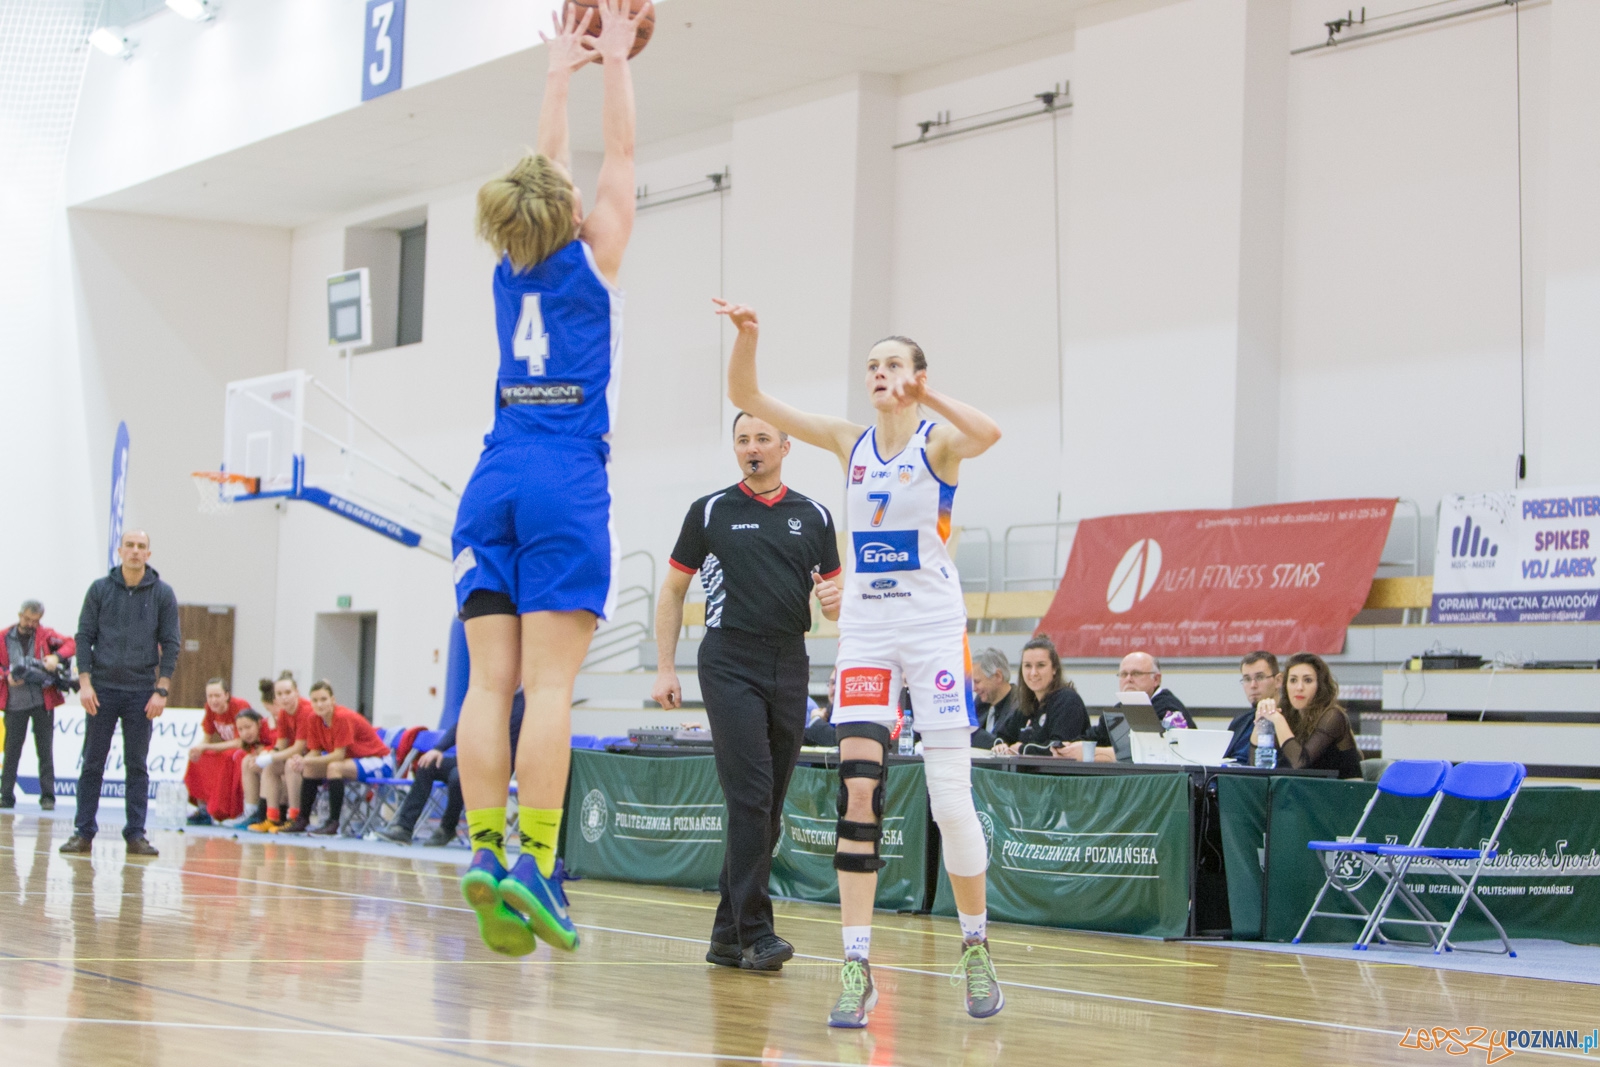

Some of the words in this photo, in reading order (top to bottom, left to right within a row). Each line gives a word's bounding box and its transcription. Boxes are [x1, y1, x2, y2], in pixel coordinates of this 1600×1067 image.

[369, 0, 395, 86] 3
[511, 292, 550, 377] 4
[328, 496, 405, 537] PESMENPOL
[867, 491, 891, 527] 7
[1535, 529, 1590, 551] SPIKER
[863, 550, 909, 563] Enea
[1472, 559, 1496, 569] MASTER
[1155, 567, 1197, 593] ALFA
[1199, 564, 1273, 589] FITNESS
[1270, 562, 1325, 589] STARS
[1522, 559, 1549, 579] VDJ
[1550, 556, 1597, 579] JAREK
[883, 591, 912, 599] Motors
[1438, 597, 1479, 611] OPRAWA
[1481, 596, 1539, 610] MUZYCZNA
[1541, 592, 1599, 609] ZAWODÓW
[845, 681, 884, 692] SZPIKU
[615, 812, 672, 831] POLITECHNIKA
[673, 812, 722, 831] POZNAŃSKA
[791, 826, 837, 846] POLITECHNI
[1001, 840, 1080, 863] POLITECHNIKA
[1085, 843, 1158, 864] POZNAŃSKA
[1428, 884, 1474, 894] UCZELNIA
[1477, 885, 1526, 895] POLITECHNIKI
[1528, 884, 1574, 895] POZNAŃSKIEJ
